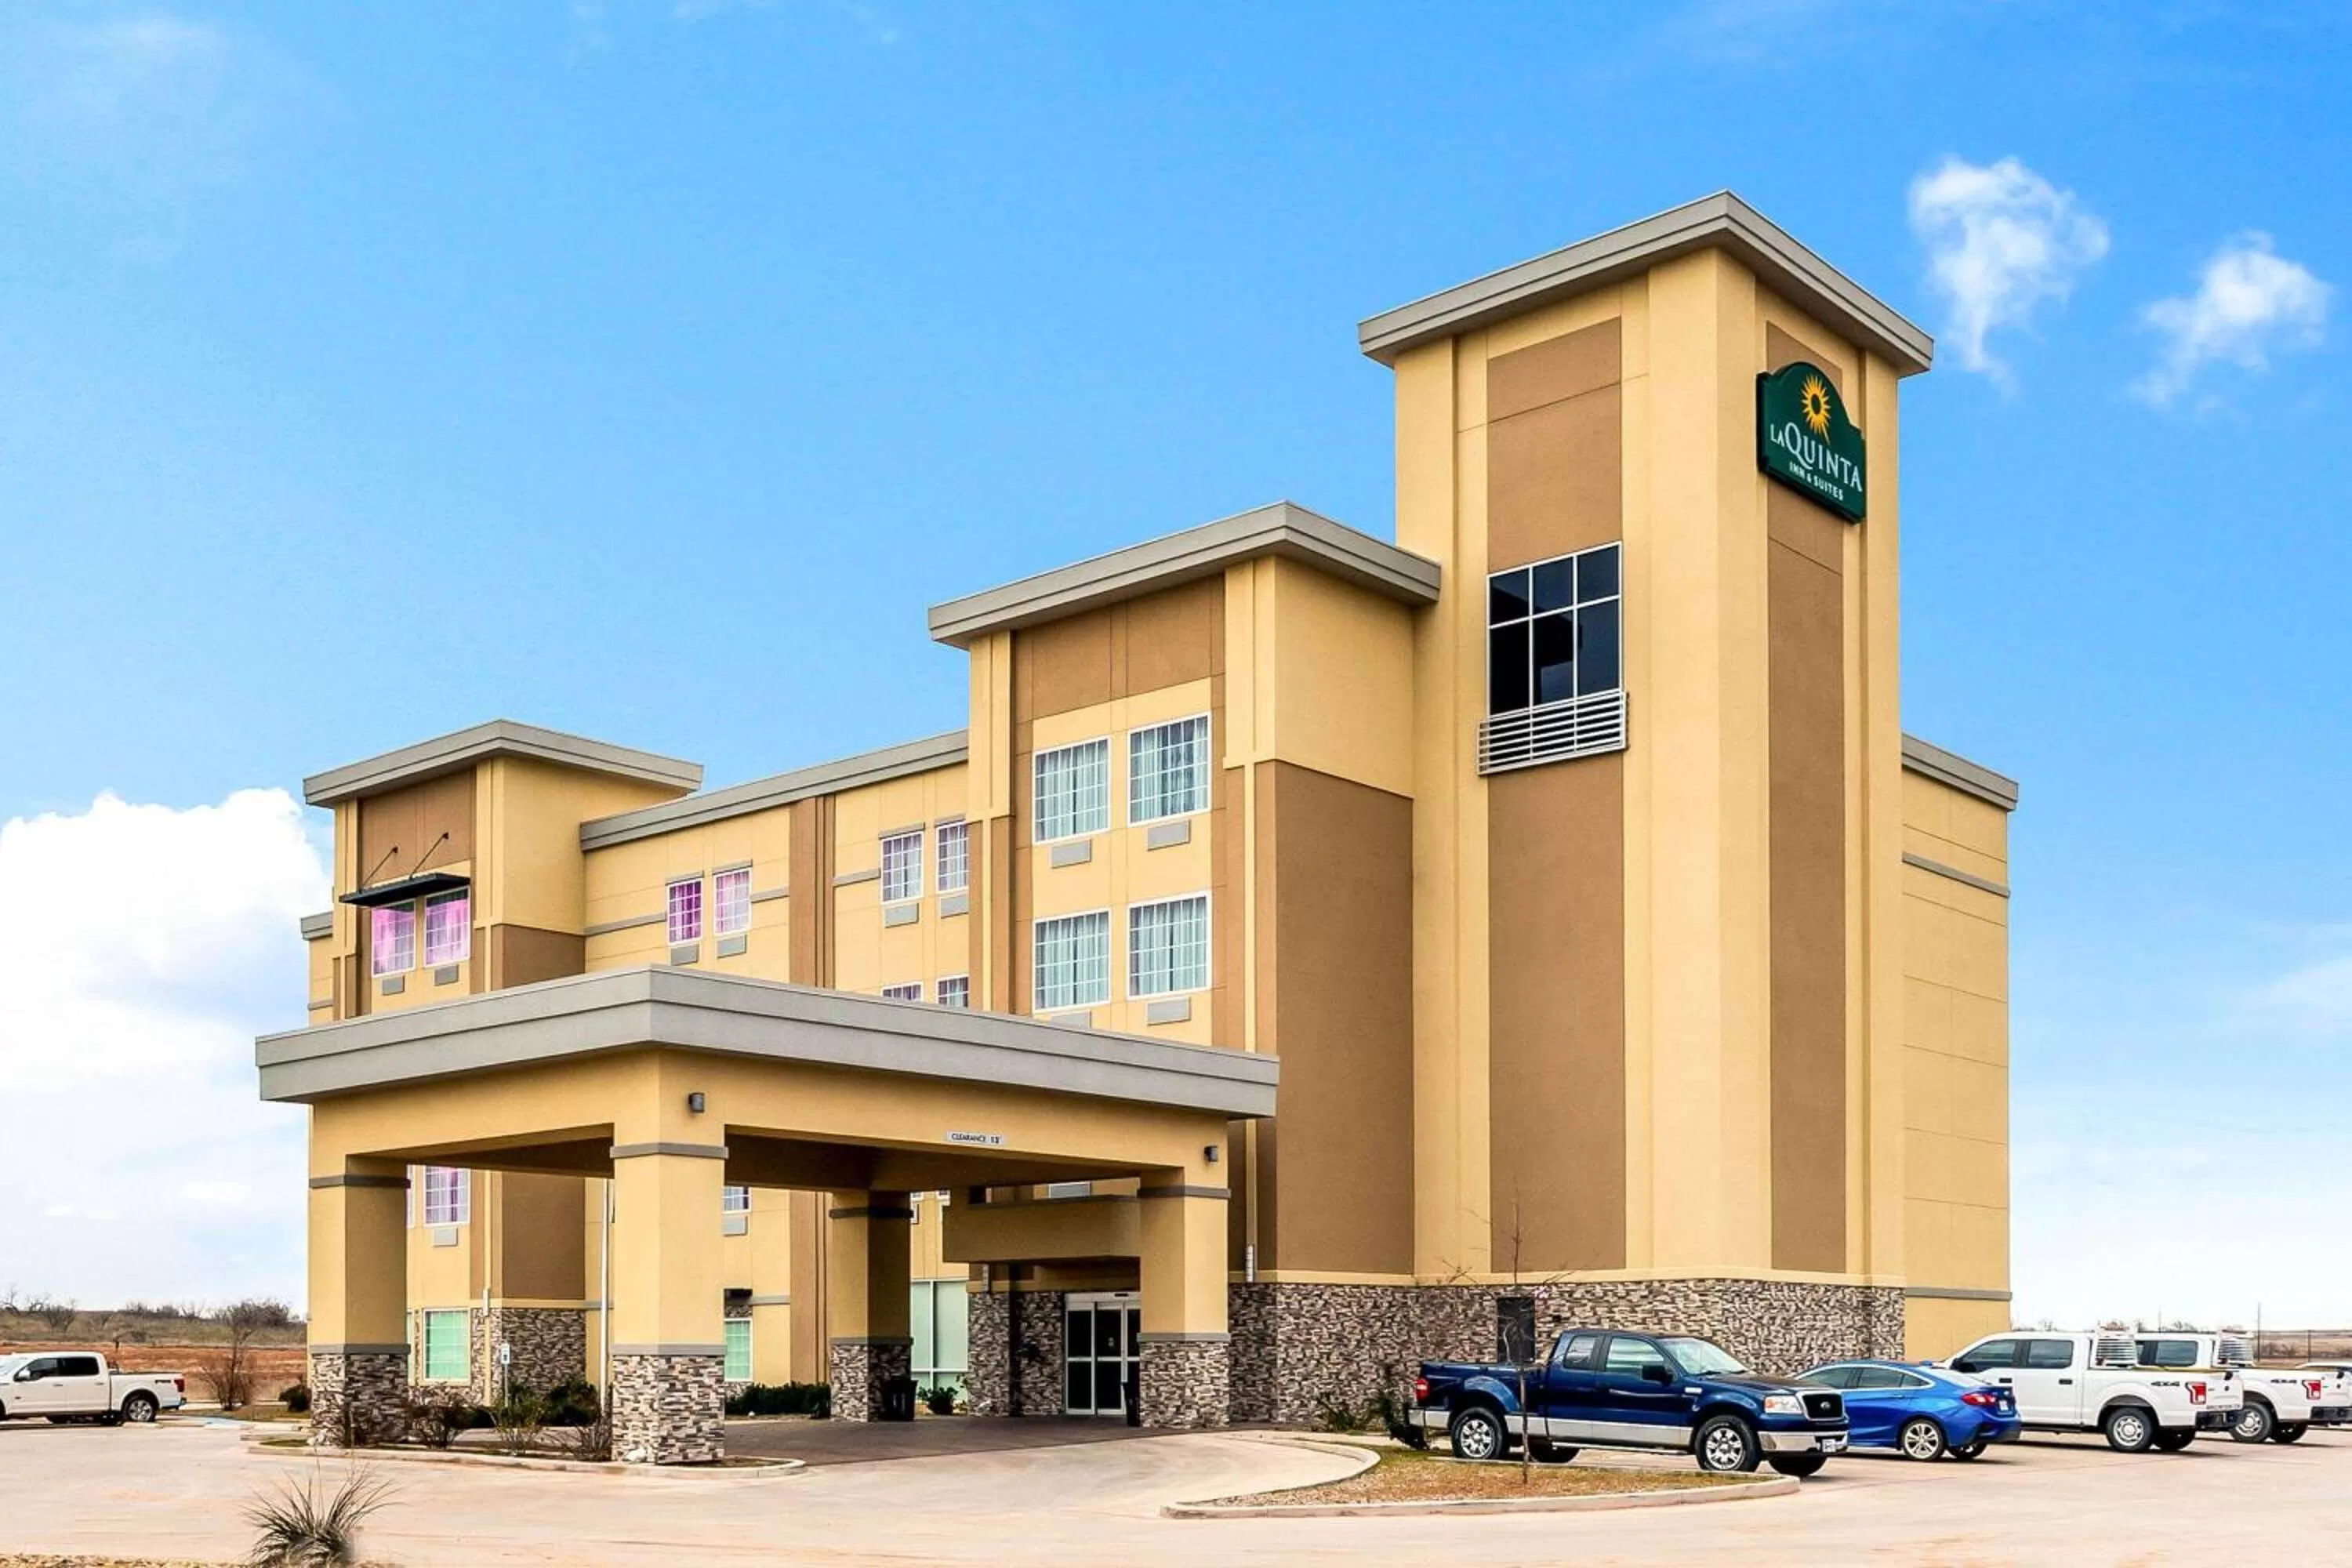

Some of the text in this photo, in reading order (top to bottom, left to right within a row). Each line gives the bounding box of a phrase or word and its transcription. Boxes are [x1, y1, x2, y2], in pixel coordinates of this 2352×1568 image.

[1770, 422, 1863, 492] LA QUINTA
[1788, 461, 1843, 501] INN & SUITES
[951, 1133, 986, 1142] CLEARANCE
